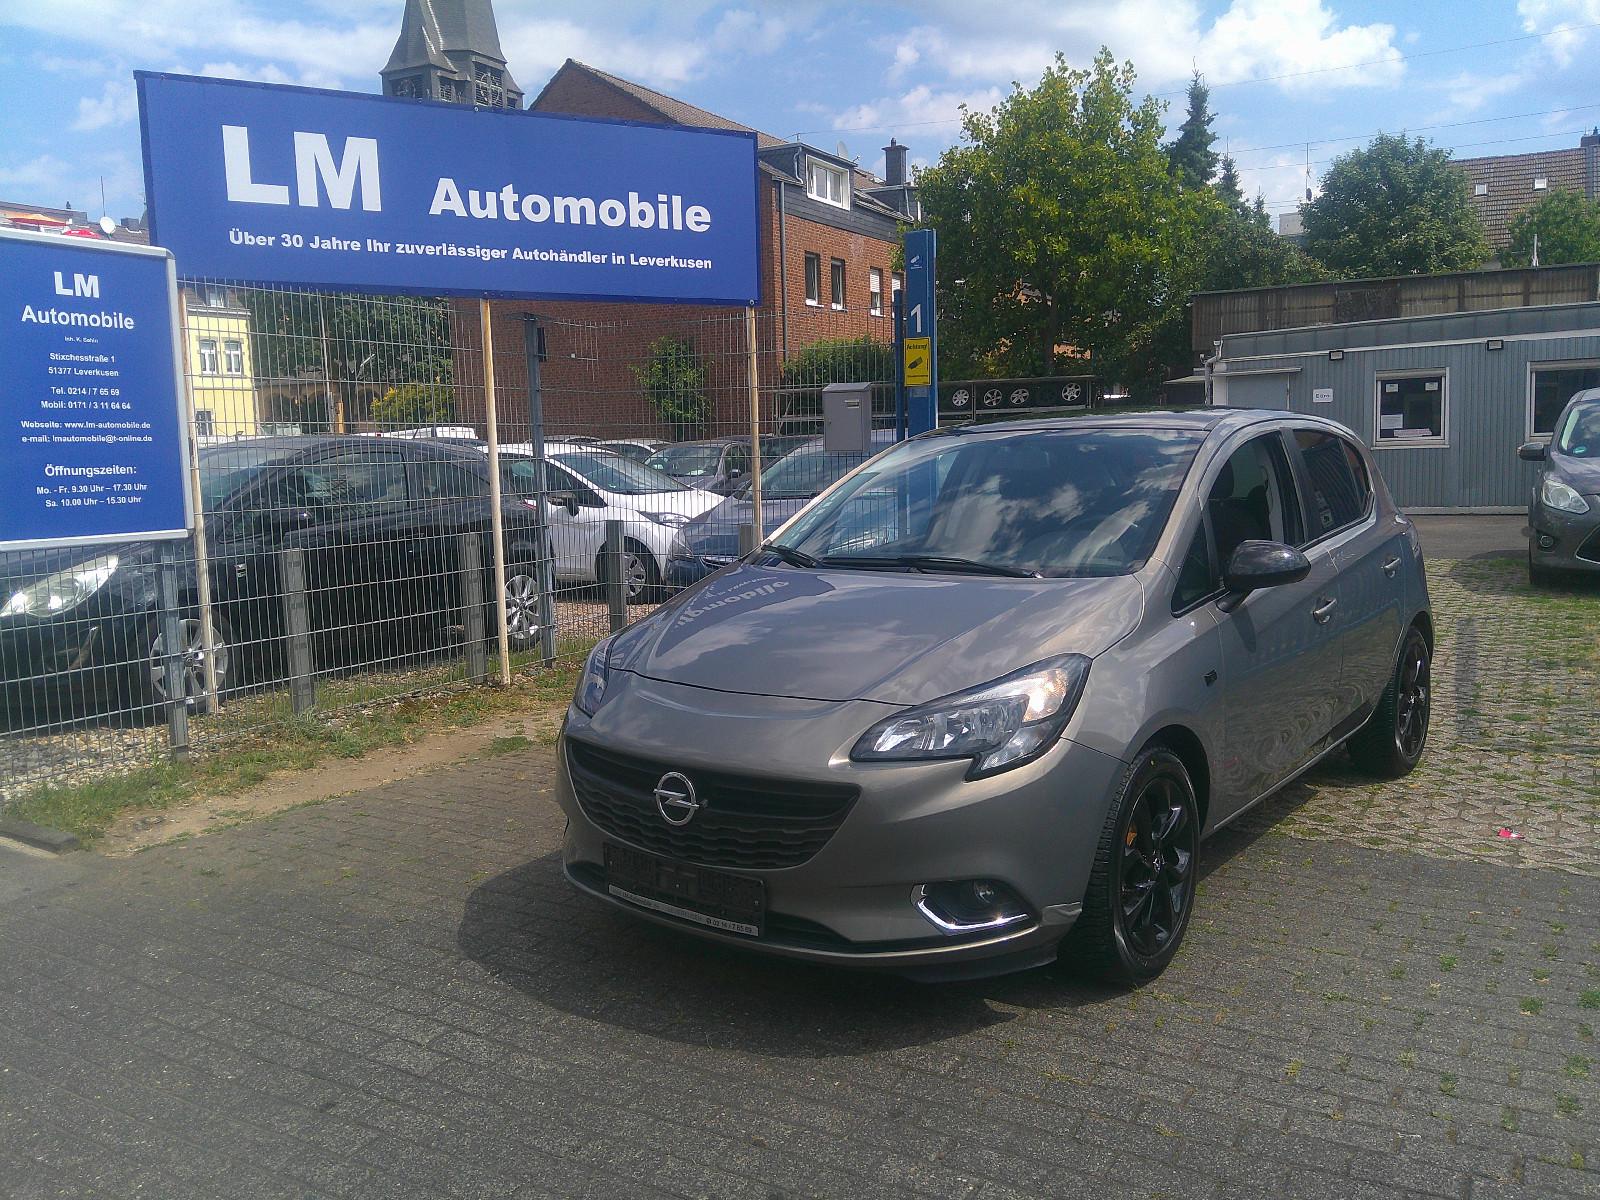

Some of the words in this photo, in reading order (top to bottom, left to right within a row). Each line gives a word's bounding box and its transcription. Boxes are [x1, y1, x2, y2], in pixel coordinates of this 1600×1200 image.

[221, 124, 382, 212] LM
[428, 177, 712, 232] Automobile
[229, 227, 275, 247] Über
[281, 234, 303, 248] 30
[310, 235, 361, 251] Jahre
[367, 239, 390, 253] Ihr
[396, 242, 508, 261] zuverlässiger
[512, 247, 607, 265] Autohändler
[611, 252, 625, 265] in
[630, 254, 712, 270] Leverkusen
[54, 271, 100, 298] LM
[21, 305, 135, 329] Automobile
[911, 304, 921, 332] 1
[50, 353, 108, 362] Stixchesstraße
[48, 367, 71, 375] 51377
[74, 368, 119, 377] Leverkusen
[51, 387, 65, 395] Tel.
[68, 387, 86, 395] 0214
[41, 401, 66, 409] Mobil:
[68, 401, 86, 409] 0171
[111, 402, 120, 410] 64
[122, 402, 130, 410] 64
[22, 435, 50, 443] e-mail:
[45, 464, 137, 477] Öffnungszeiten:
[36, 487, 51, 495] Mo.
[59, 486, 69, 494] Fr.
[72, 485, 88, 493] 9.30
[134, 483, 148, 491] Uhr
[45, 499, 58, 507] Sa.
